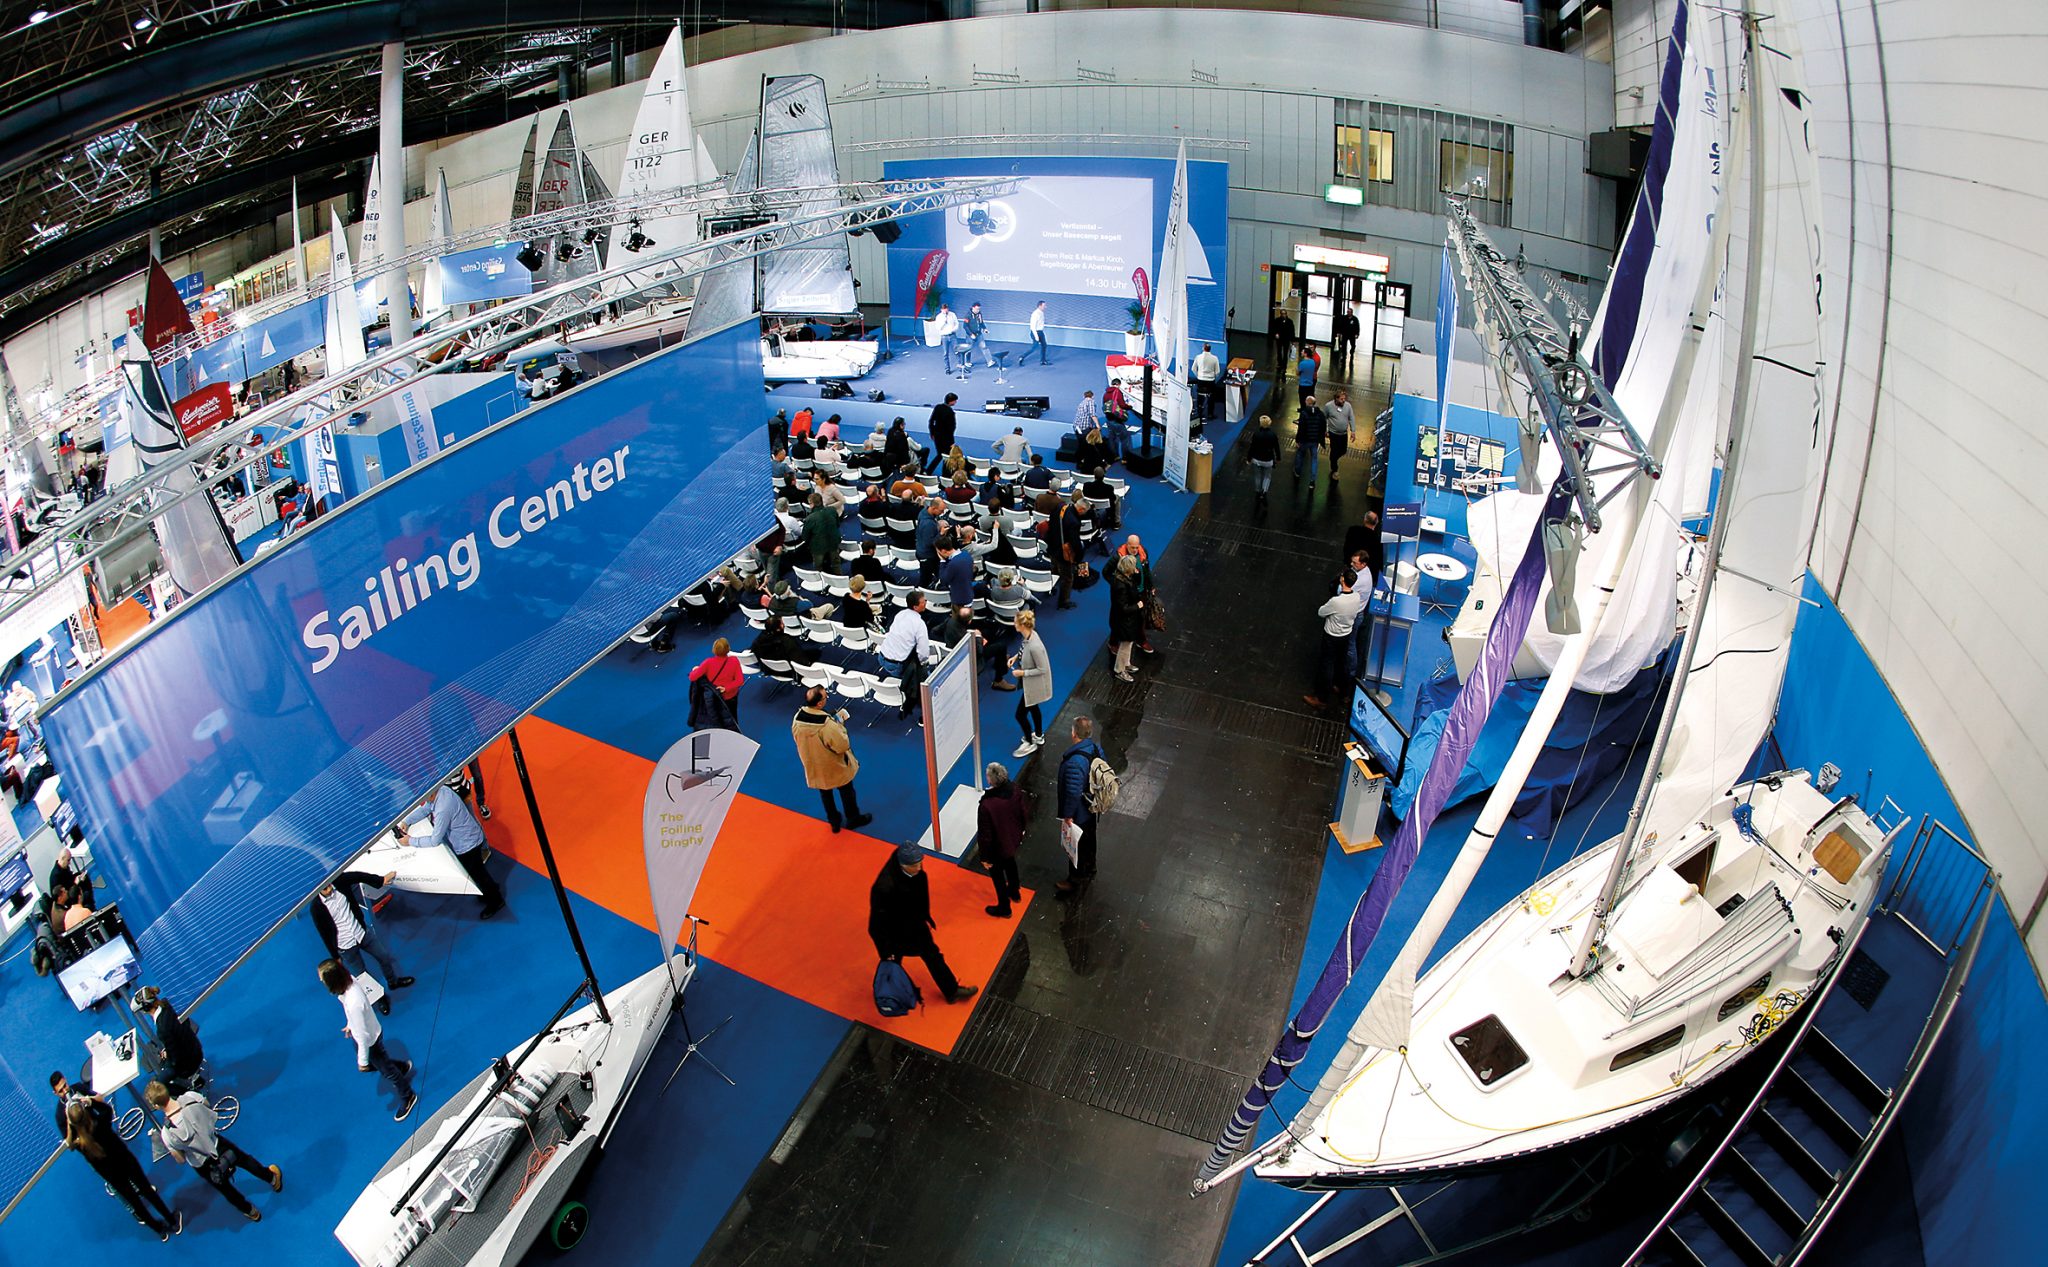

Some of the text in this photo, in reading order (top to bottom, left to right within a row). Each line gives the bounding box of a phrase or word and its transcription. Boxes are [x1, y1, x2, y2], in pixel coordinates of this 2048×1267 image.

[664, 81, 671, 90] F
[639, 131, 669, 145] GER
[633, 156, 662, 170] 1122
[518, 182, 532, 191] GER
[543, 180, 569, 191] GER
[365, 213, 380, 221] NED
[1064, 232, 1099, 241] Basecamp
[966, 272, 1020, 283] Sailing Center
[1085, 278, 1109, 288] 14.30
[1111, 279, 1128, 289] Uhr
[302, 444, 630, 675] Sailing Center
[660, 813, 684, 823] The
[660, 823, 703, 835] Foiling
[661, 835, 704, 849] Dinghy
